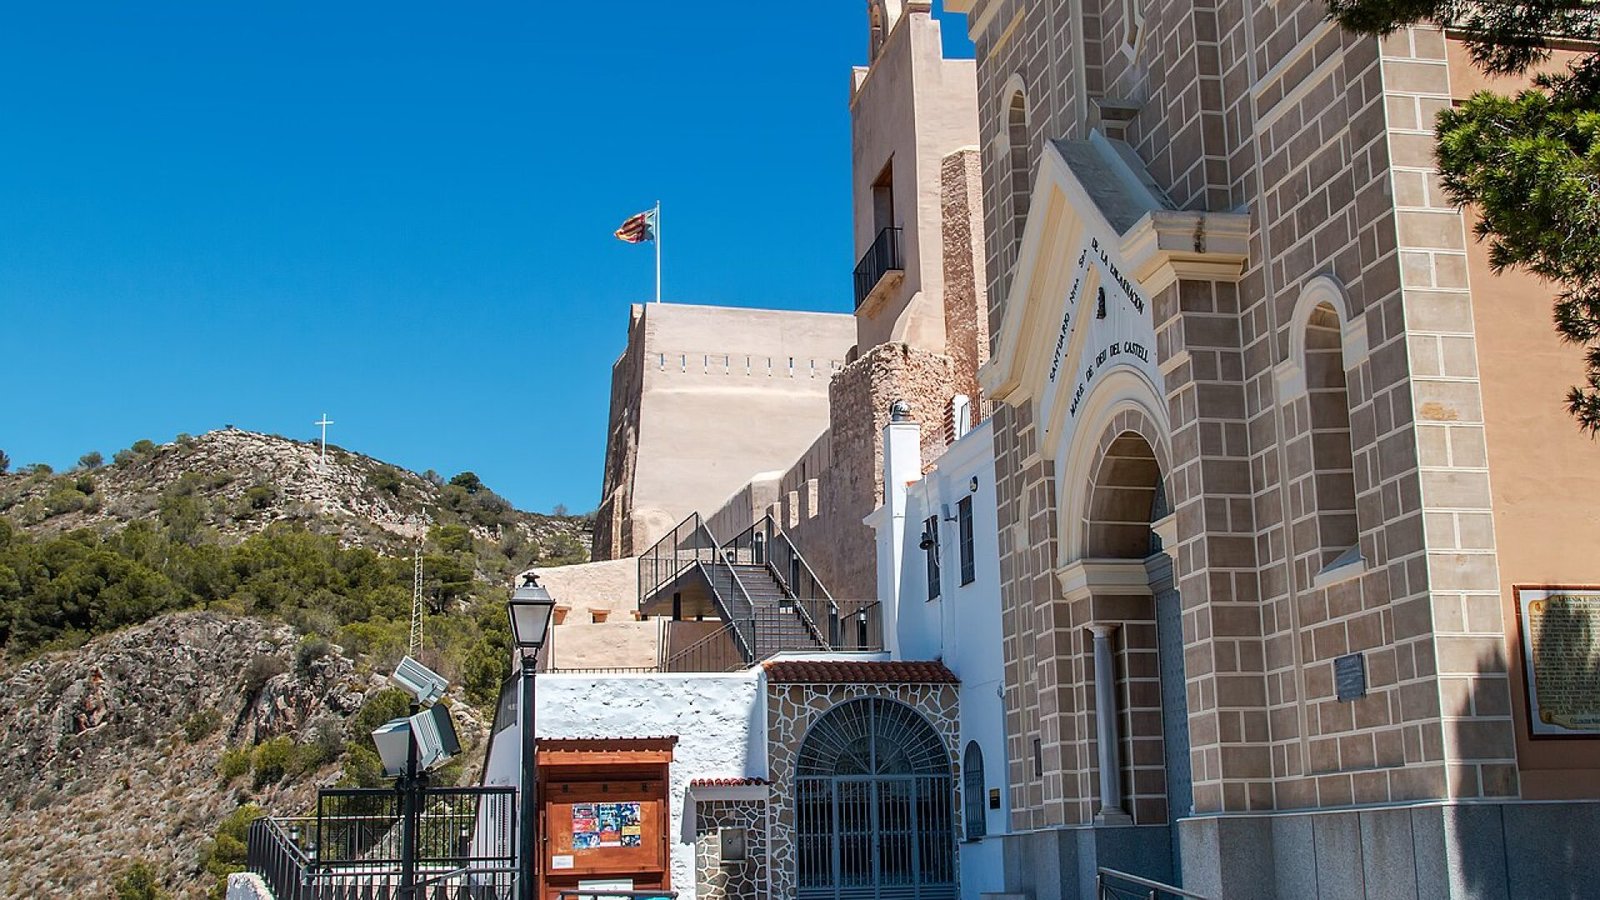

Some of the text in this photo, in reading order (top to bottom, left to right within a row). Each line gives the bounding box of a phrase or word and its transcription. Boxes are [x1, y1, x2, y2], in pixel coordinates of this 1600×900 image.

[1049, 312, 1070, 383] SANTUARIO
[1091, 236, 1099, 253] DE
[1100, 250, 1109, 267] LA
[1069, 341, 1149, 418] MARE DE DEU DEL CASTELL
